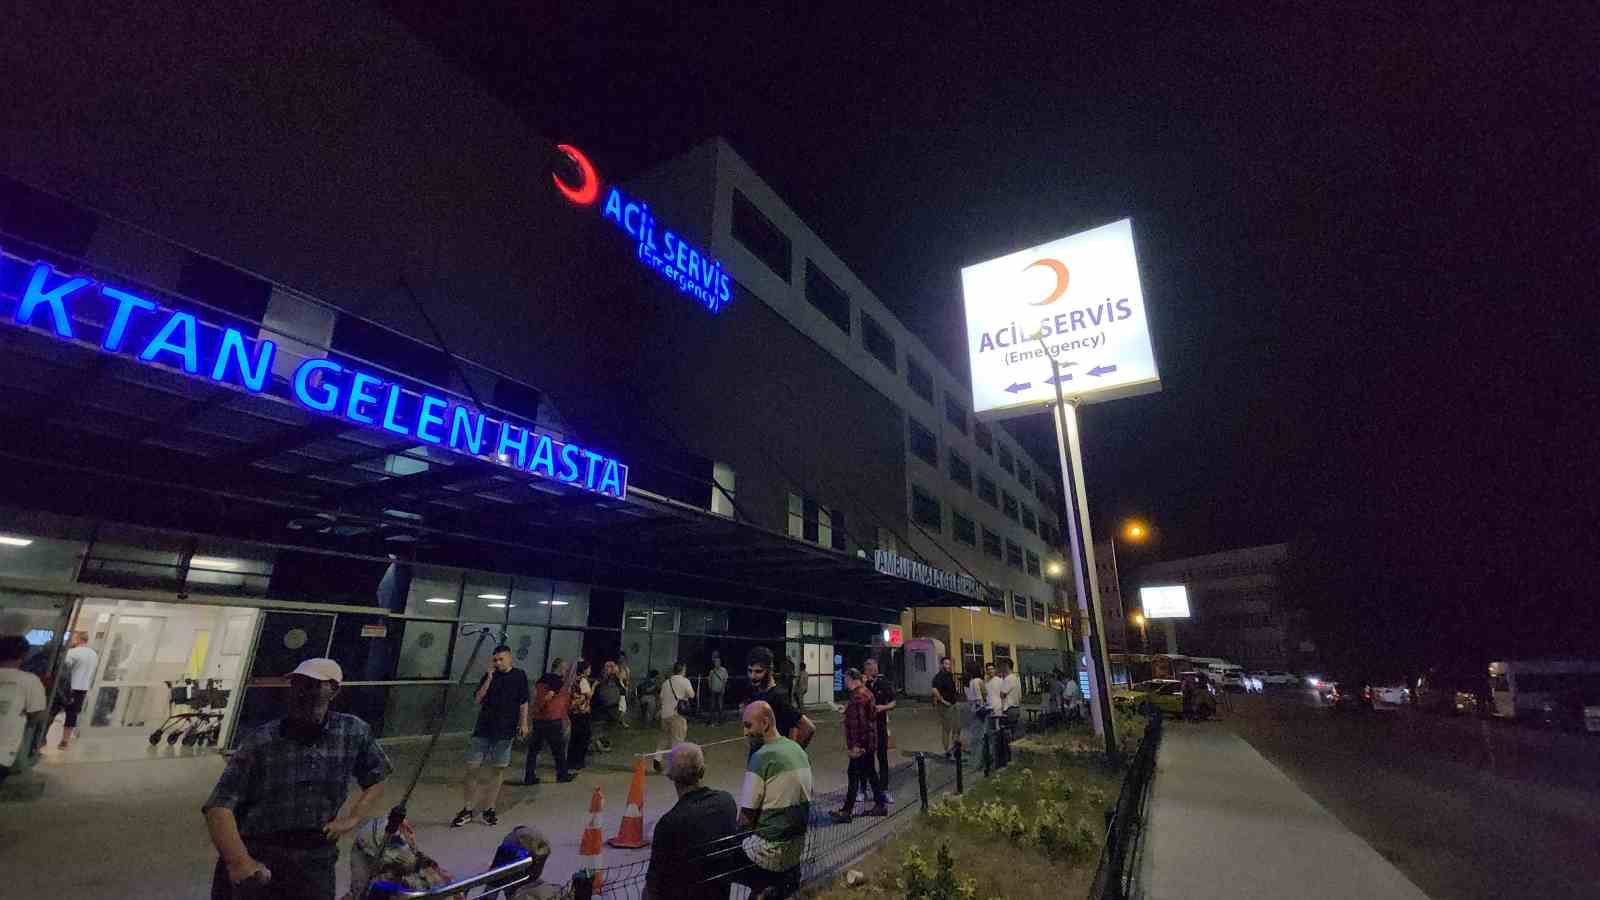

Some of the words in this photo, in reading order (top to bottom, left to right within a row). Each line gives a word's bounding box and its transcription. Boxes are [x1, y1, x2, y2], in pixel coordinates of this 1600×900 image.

[663, 232, 732, 302] SERVİS
[1040, 298, 1132, 338] SERVİS
[292, 357, 486, 455] GELEN
[497, 422, 622, 497] HASTA
